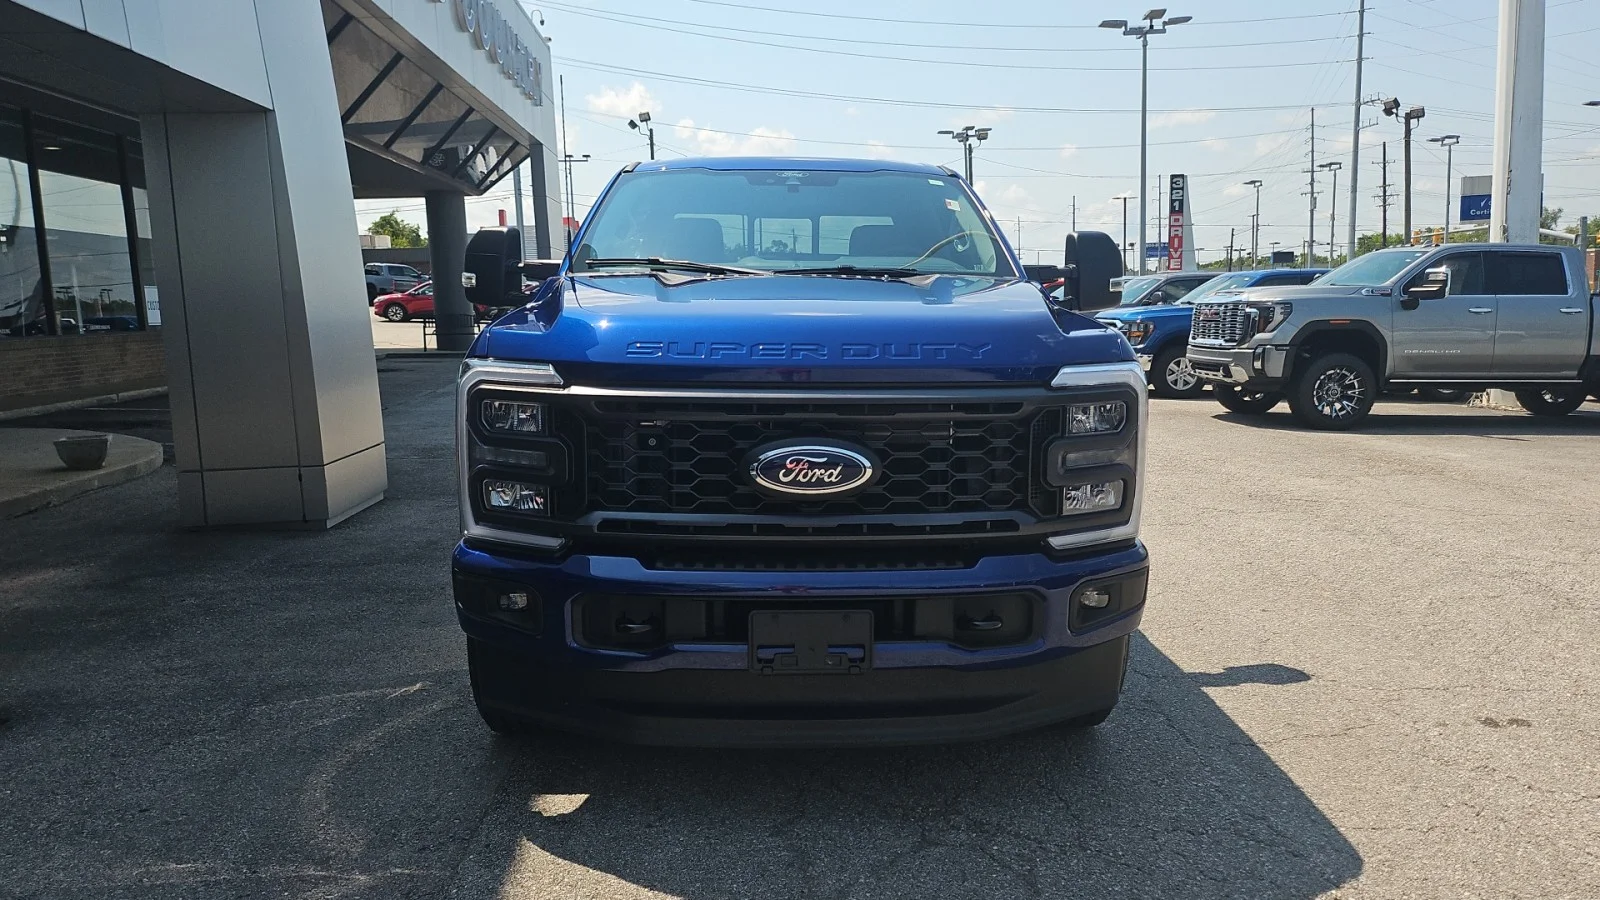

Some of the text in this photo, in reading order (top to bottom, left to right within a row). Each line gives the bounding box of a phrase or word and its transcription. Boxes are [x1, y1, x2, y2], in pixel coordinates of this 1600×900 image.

[1171, 177, 1184, 211] 321
[1169, 215, 1183, 269] DRIVE
[625, 341, 992, 360] SUPER DUTY
[779, 456, 842, 483] Ford
